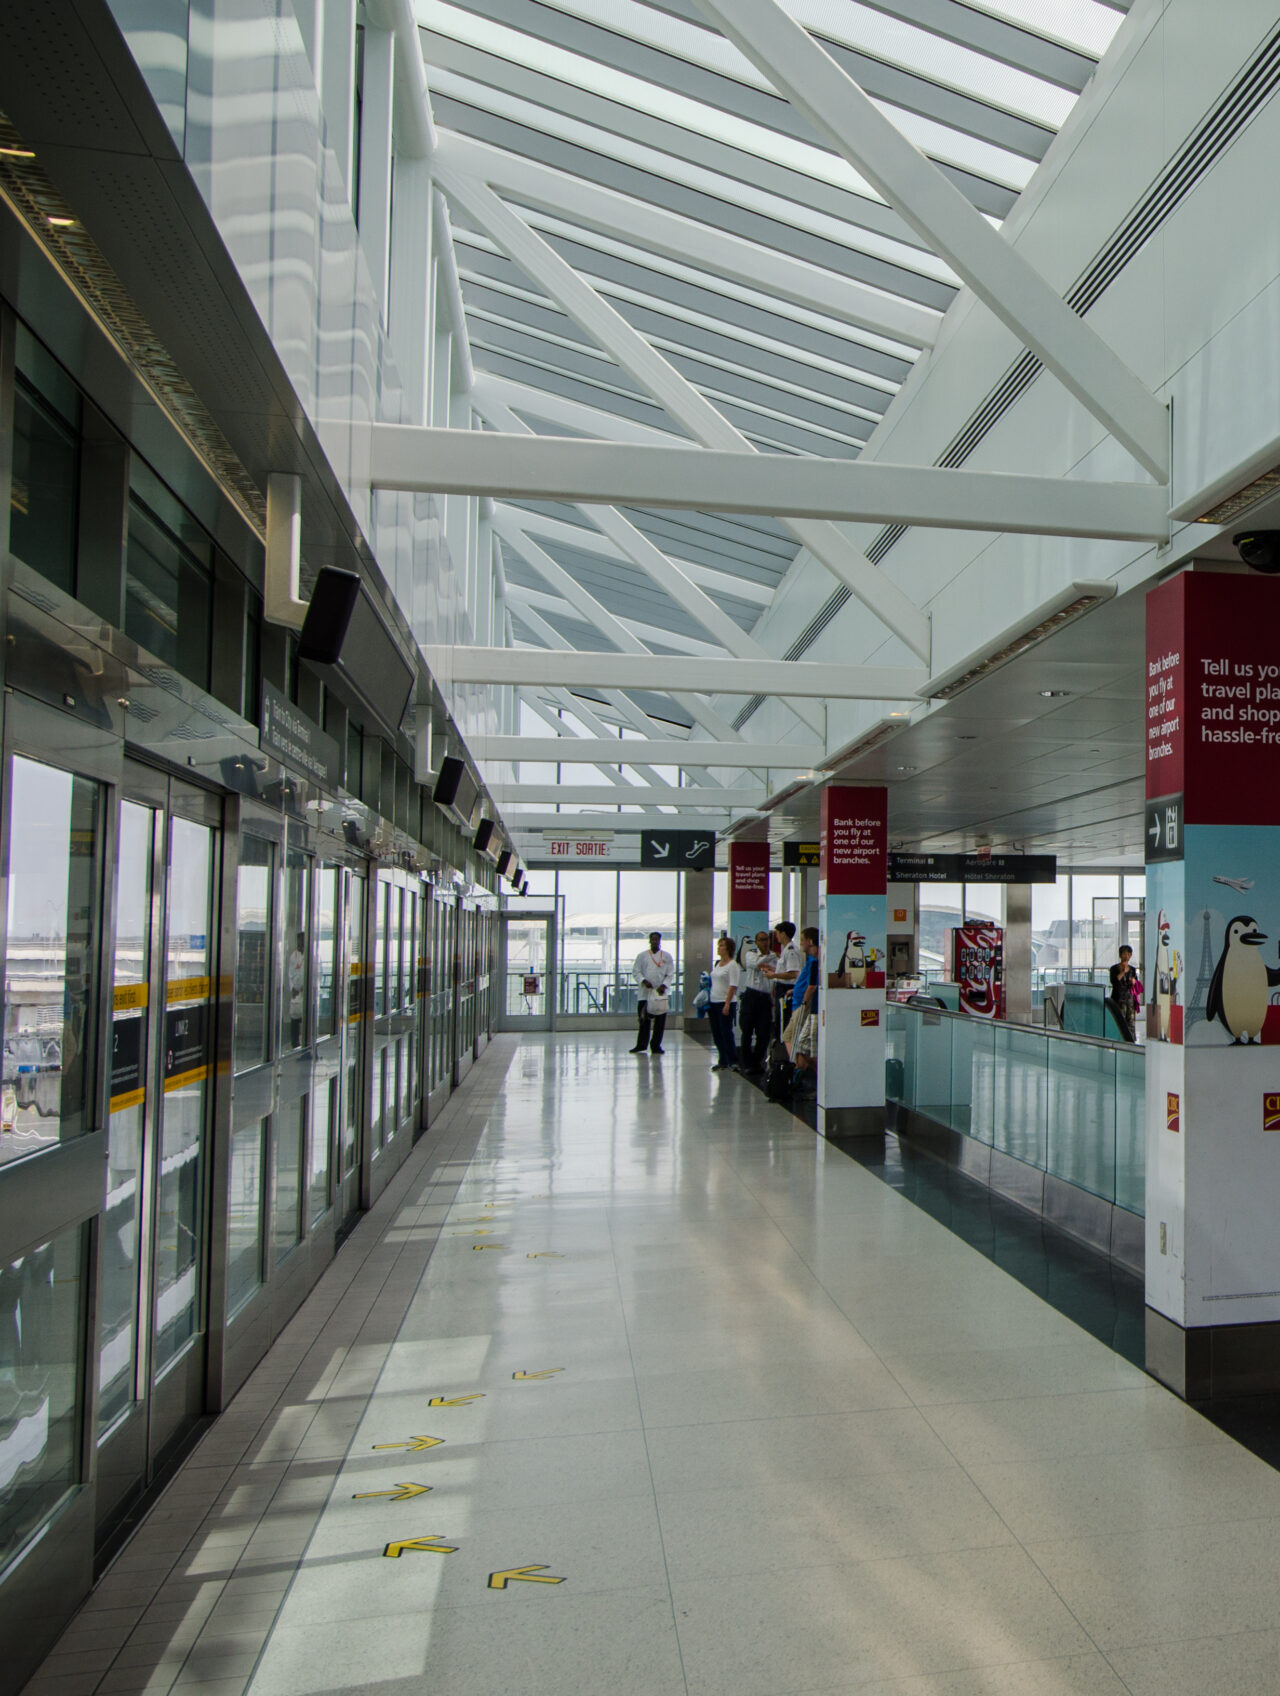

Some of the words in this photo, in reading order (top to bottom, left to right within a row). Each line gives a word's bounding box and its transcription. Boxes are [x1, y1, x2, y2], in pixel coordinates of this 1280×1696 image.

[1149, 656, 1161, 676] Bank
[1162, 652, 1179, 670] before
[1201, 659, 1229, 675] Tell
[1234, 664, 1253, 676] us
[1149, 683, 1158, 701] you
[1159, 677, 1167, 695] fly
[1167, 676, 1173, 690] at
[1201, 682, 1250, 698] travel
[1149, 705, 1158, 718] one
[1159, 698, 1166, 714] of
[1166, 698, 1175, 711] our
[1202, 704, 1234, 720] and
[1239, 705, 1280, 726] shop
[1149, 725, 1160, 739] new
[1161, 716, 1179, 737] airport
[1149, 741, 1173, 760] branches.
[834, 818, 853, 826] Bank
[855, 818, 880, 827] before
[834, 829, 848, 837] you
[850, 828, 861, 837] fly
[552, 842, 570, 854] EXIT
[576, 843, 606, 856] SORTIE
[853, 847, 880, 856] airport
[834, 856, 870, 864] branches.
[897, 857, 926, 865] Terminal
[1167, 1096, 1179, 1112] CIBC
